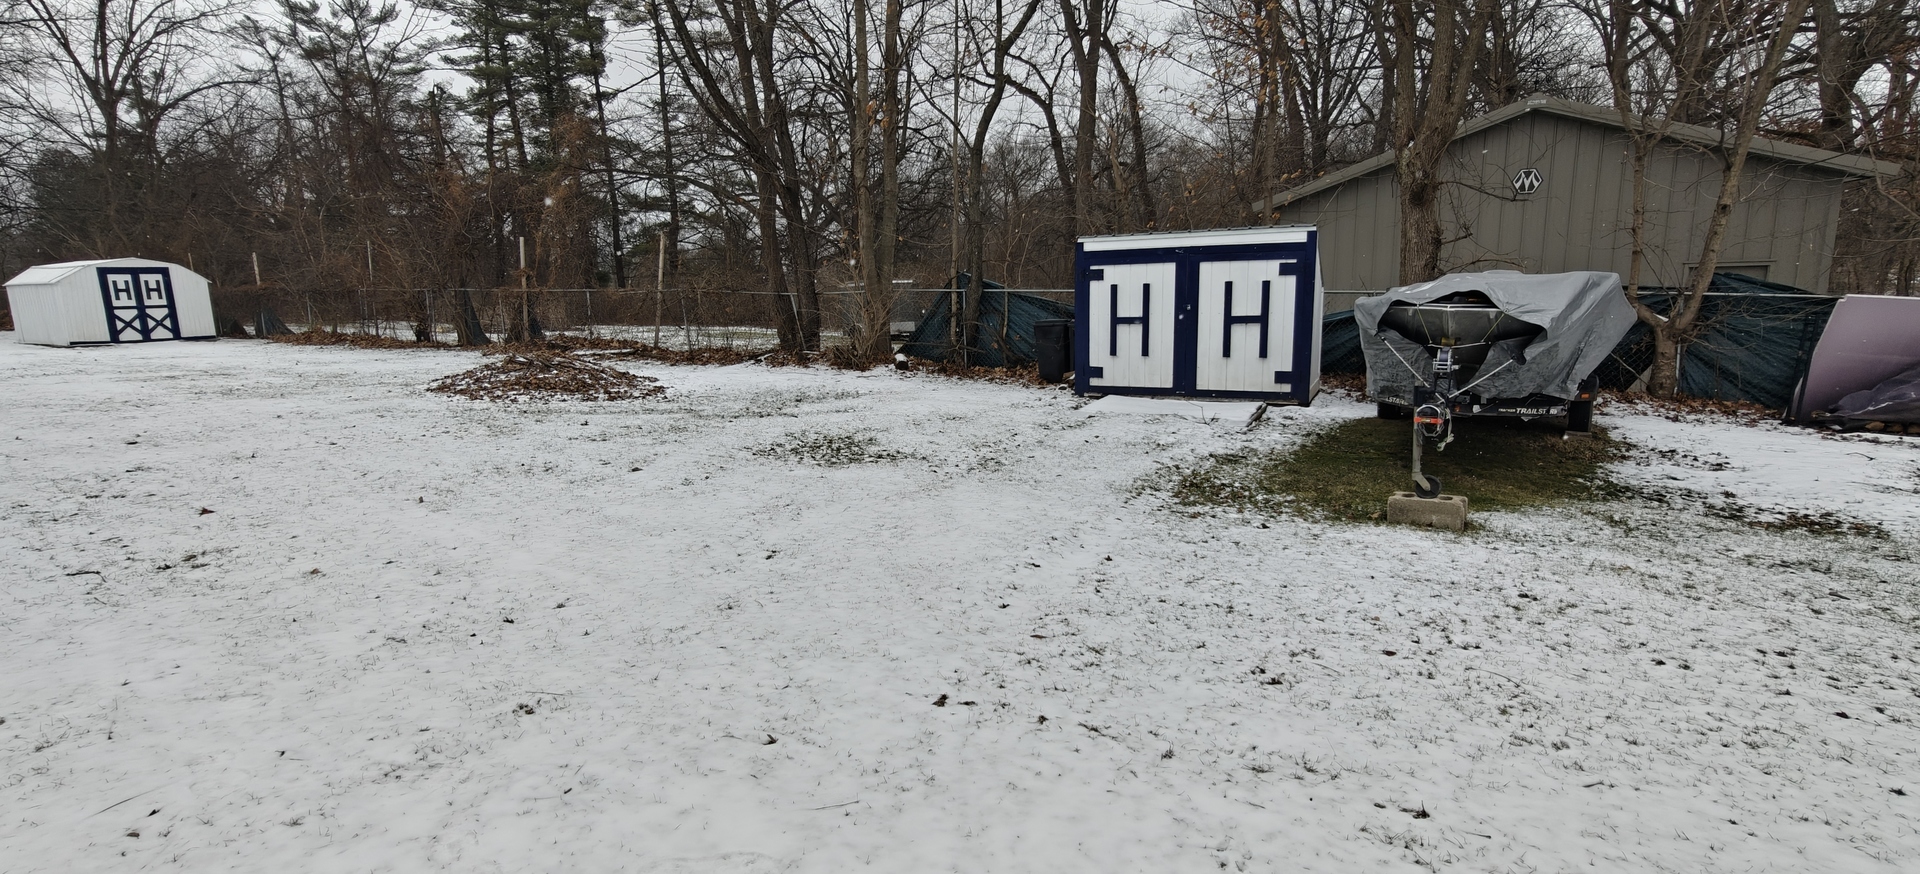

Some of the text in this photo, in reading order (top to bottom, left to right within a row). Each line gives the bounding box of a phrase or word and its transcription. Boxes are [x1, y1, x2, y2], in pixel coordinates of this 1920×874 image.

[112, 279, 163, 301] H H
[1110, 280, 1270, 358] H H
